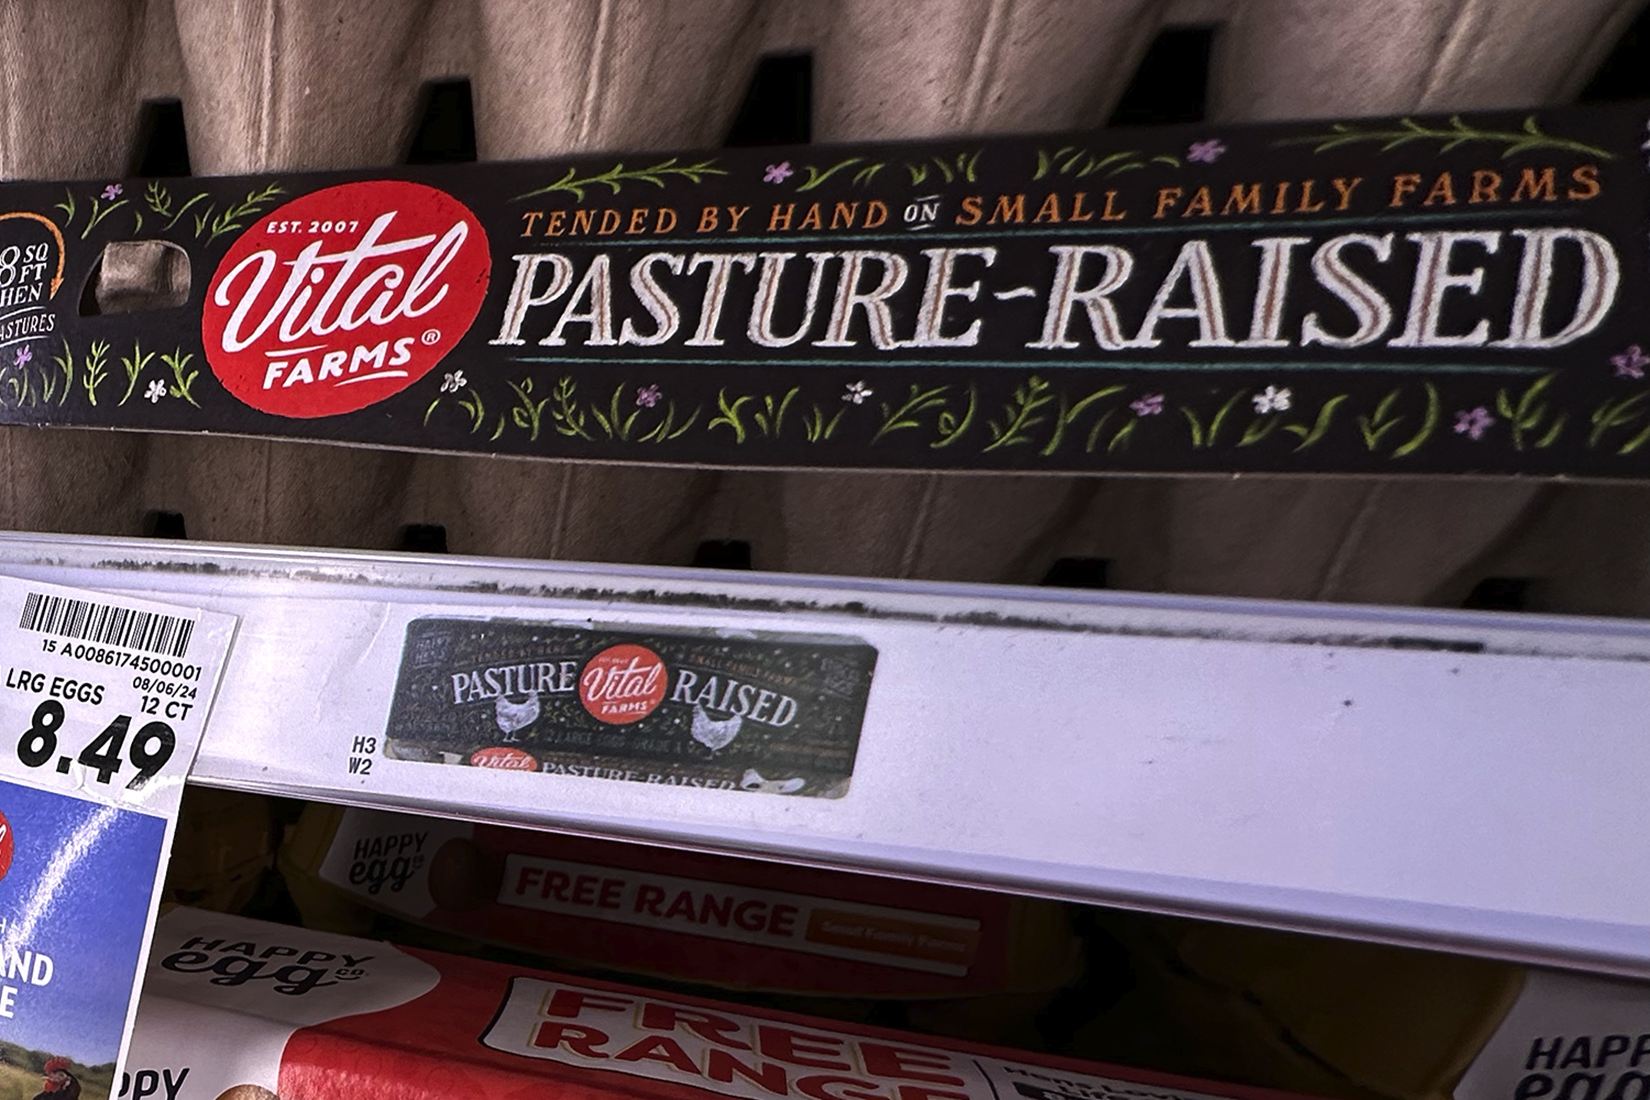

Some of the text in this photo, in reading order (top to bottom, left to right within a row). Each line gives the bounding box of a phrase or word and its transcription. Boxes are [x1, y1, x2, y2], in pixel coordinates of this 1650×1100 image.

[308, 219, 358, 236] 2007
[520, 205, 750, 239] TENDED BY
[23, 242, 51, 268] SQ
[19, 262, 48, 285] FT
[214, 210, 470, 355] Vital
[488, 227, 1621, 350] PASTURE-RAISED
[262, 342, 412, 390] FARMS
[42, 639, 57, 653] 15
[6, 669, 45, 694] LRG
[50, 677, 106, 708] EGGS
[132, 676, 198, 702] 08/06/24
[451, 661, 799, 729] PASTURE RAISED
[140, 695, 194, 722] 12 CT
[601, 701, 647, 714] FARMS
[352, 736, 377, 755] H3
[348, 756, 372, 776] W2
[349, 856, 413, 894] egg
[180, 936, 375, 968] HAPPY
[544, 987, 967, 1088] FREE
